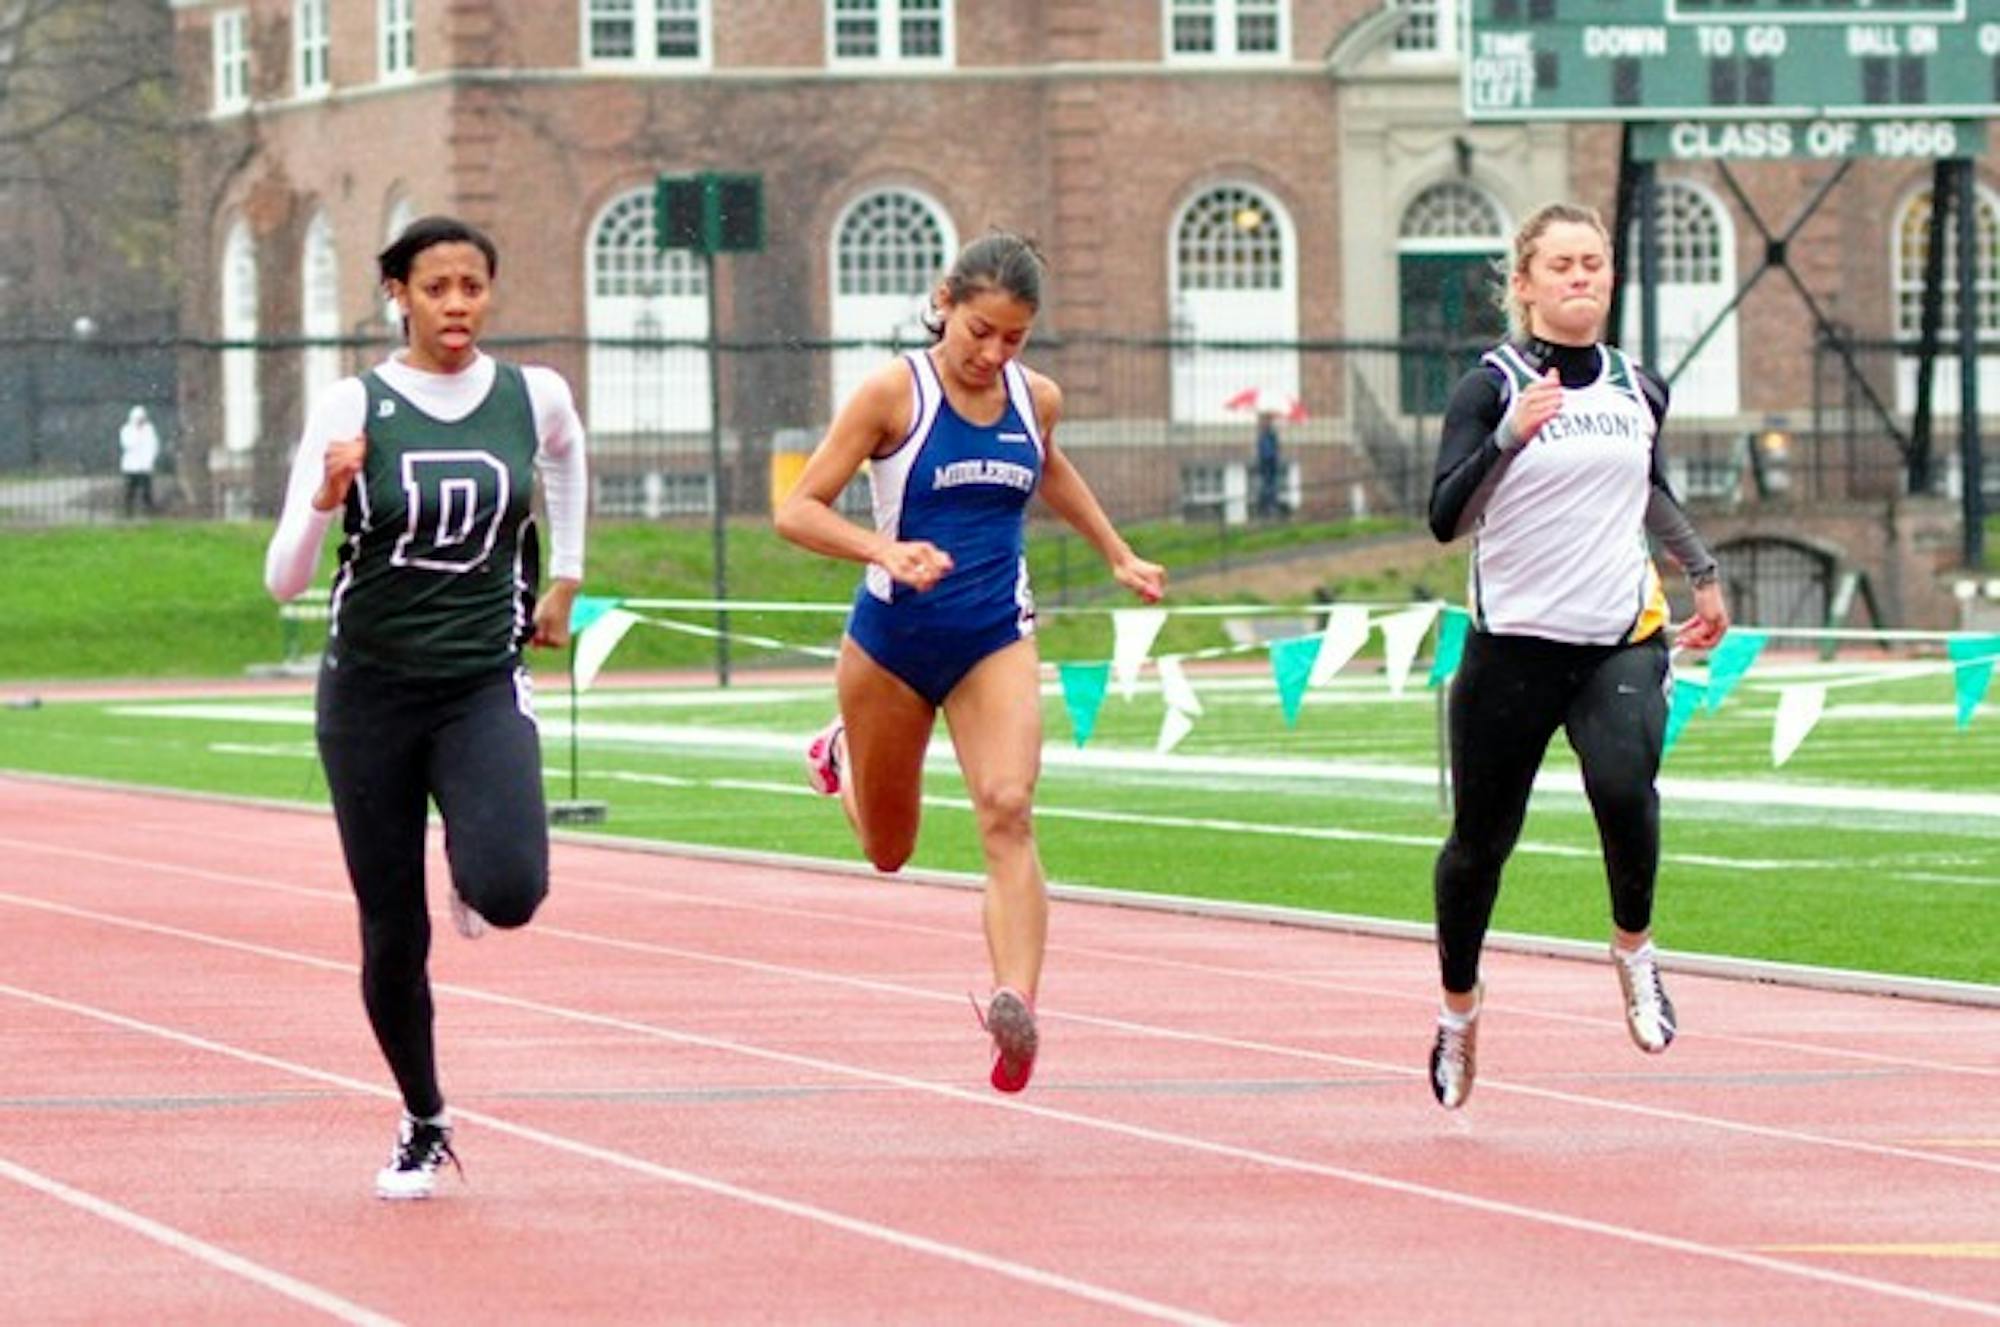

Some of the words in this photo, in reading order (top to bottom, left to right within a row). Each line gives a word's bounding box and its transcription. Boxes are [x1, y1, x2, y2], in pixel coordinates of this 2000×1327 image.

[1479, 31, 1534, 56] TIME
[1583, 25, 1667, 56] DOWN
[1698, 25, 1734, 55] TO
[1745, 25, 1787, 55] GO
[1847, 25, 1901, 55] BALL
[1907, 25, 1938, 54] ON
[1475, 82, 1533, 106] LEFT
[1670, 121, 1793, 158] CLASS
[1806, 121, 1857, 157] OF
[1872, 121, 1957, 157] 1966
[389, 451, 510, 573] D
